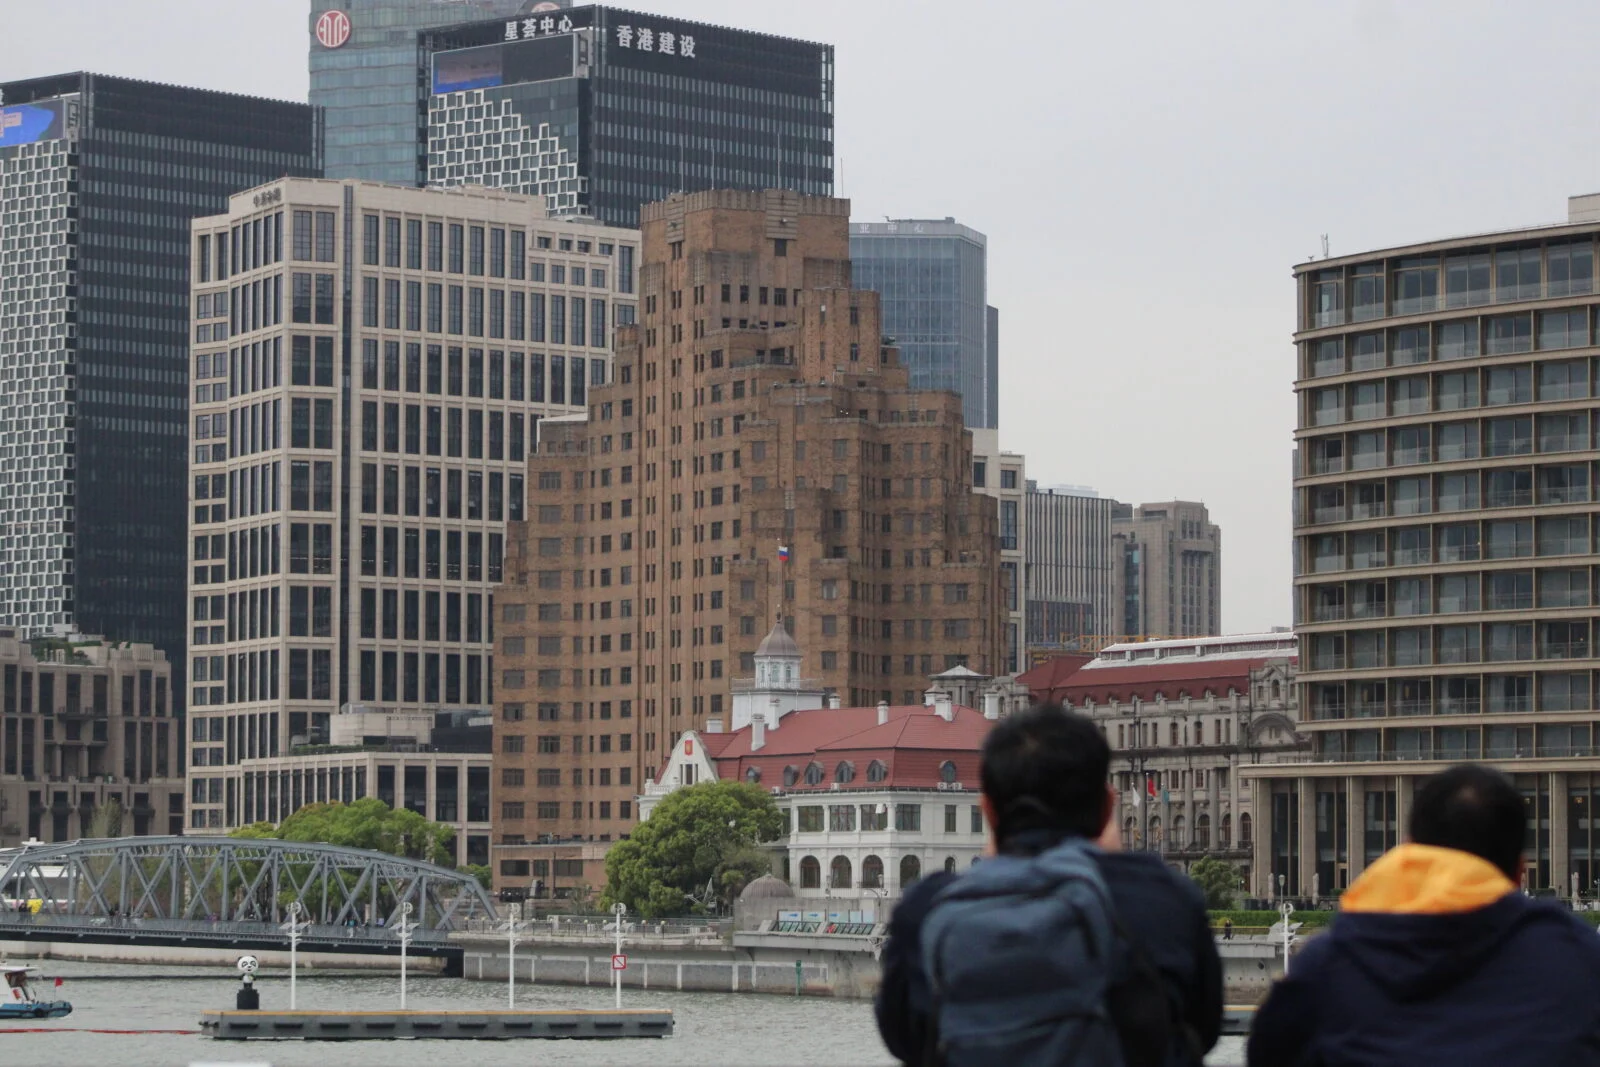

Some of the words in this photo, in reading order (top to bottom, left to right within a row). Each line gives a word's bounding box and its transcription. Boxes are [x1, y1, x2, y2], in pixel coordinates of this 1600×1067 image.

[504, 14, 573, 41] 星荟中心
[616, 25, 696, 58] 香港建设
